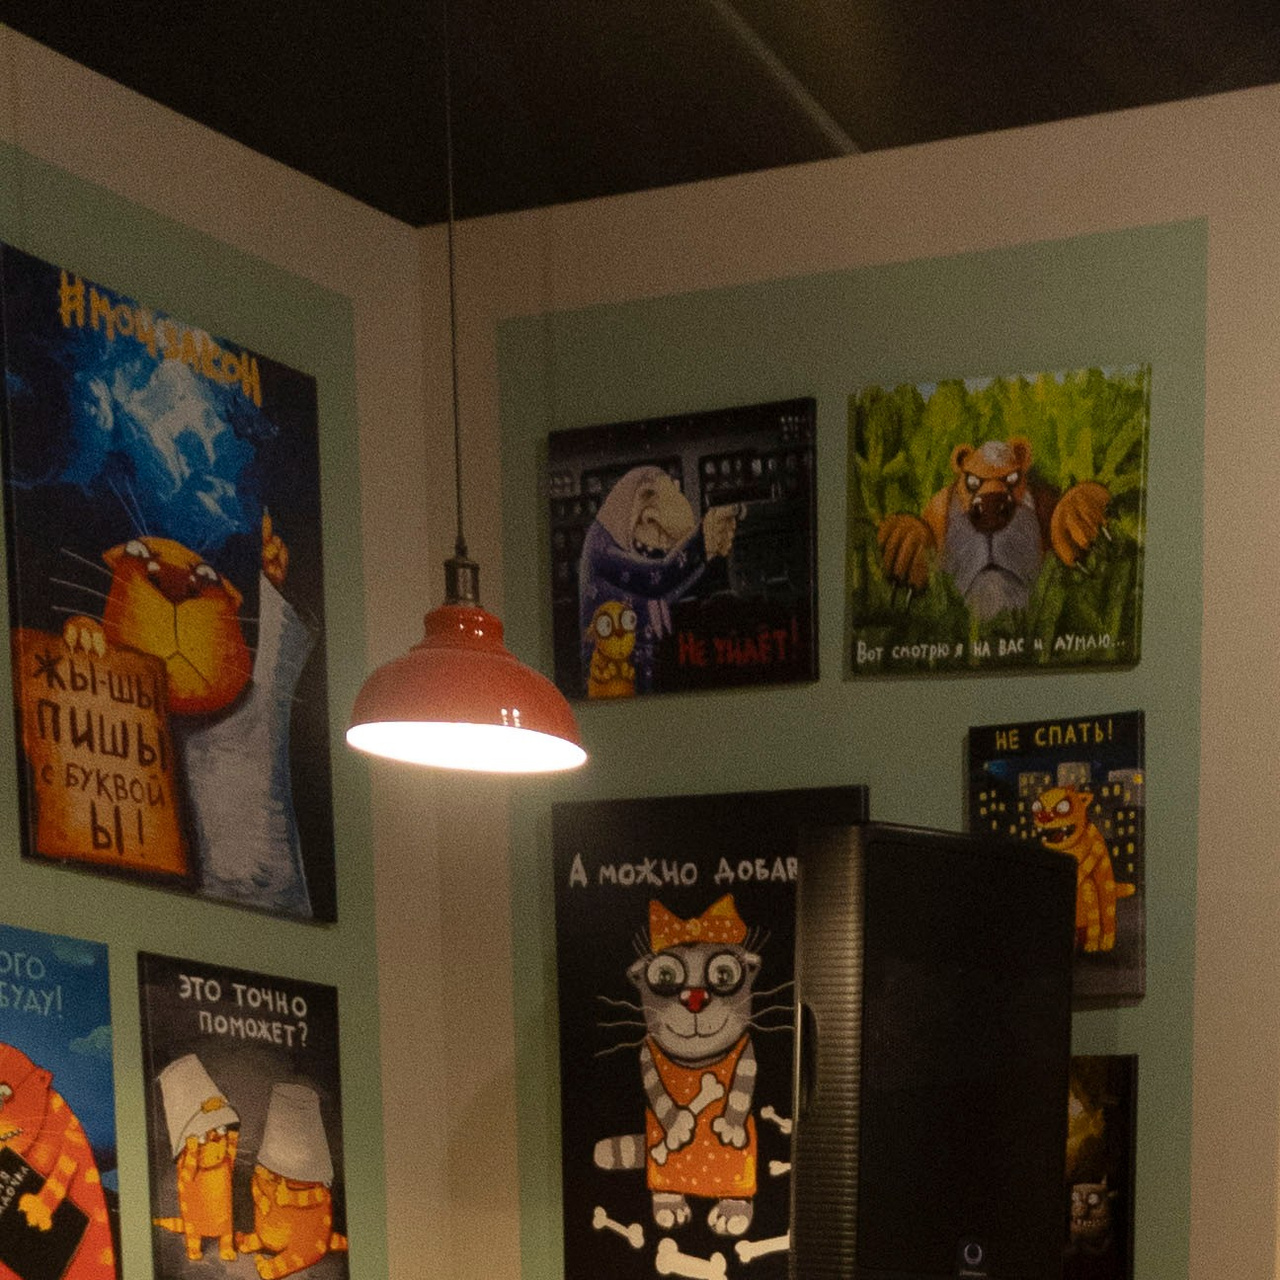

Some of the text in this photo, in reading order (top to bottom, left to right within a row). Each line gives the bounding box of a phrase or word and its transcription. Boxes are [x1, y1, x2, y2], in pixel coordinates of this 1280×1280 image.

[996, 719, 1113, 750] НЕ СПАТЬ!
[65, 762, 166, 808] БУКВОЙ
[569, 852, 588, 888] А
[179, 974, 308, 1018] ЭТО ТОЧНО
[199, 1010, 308, 1048] ПОМОЖЕТ?
